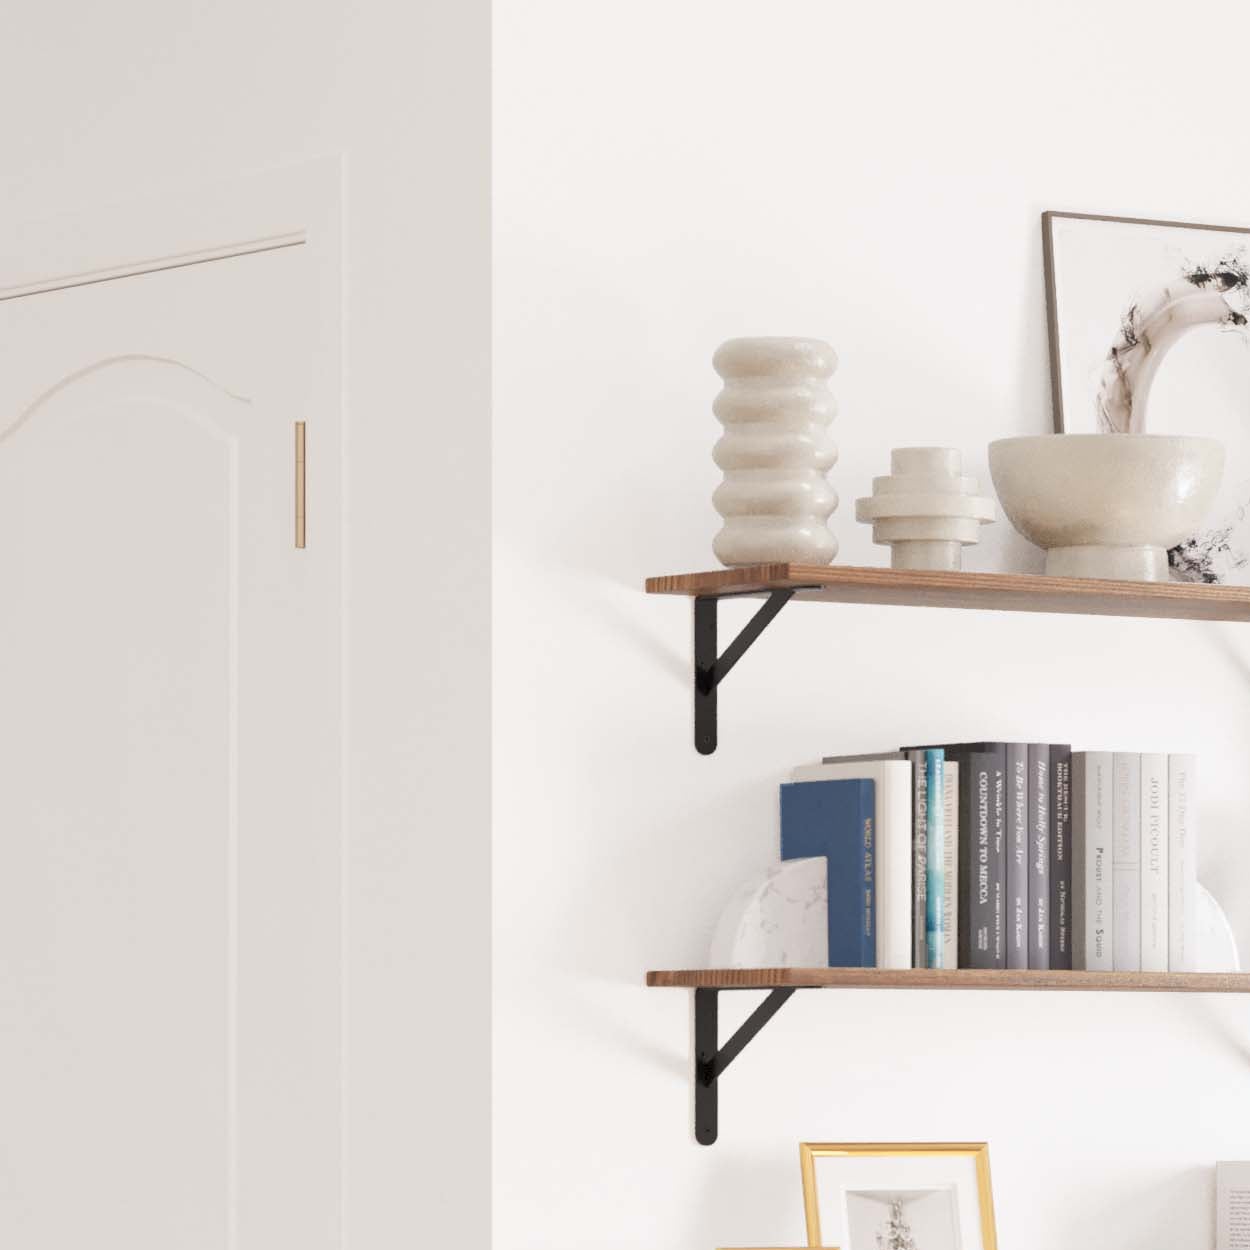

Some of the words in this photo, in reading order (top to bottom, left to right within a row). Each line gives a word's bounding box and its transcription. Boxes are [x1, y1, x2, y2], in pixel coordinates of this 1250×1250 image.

[917, 762, 928, 787] THE
[1015, 761, 1024, 774] To
[1037, 761, 1046, 790] Home
[1015, 775, 1024, 788] Be
[1150, 777, 1160, 809] JODI
[978, 771, 988, 844] COUNTDOWN
[1015, 790, 1024, 823] Where
[1037, 793, 1046, 803] to
[917, 791, 928, 834] LIGHT
[1036, 804, 1046, 832] Holly
[917, 837, 928, 853] OF
[1015, 825, 1024, 845] You
[1150, 815, 1160, 875] PICOULT
[978, 847, 988, 863] TO
[1015, 846, 1024, 865] Are
[1036, 834, 1046, 875] Springs
[978, 865, 988, 905] MECCA
[1096, 887, 1104, 905] AND
[1096, 910, 1104, 924] THE
[1096, 929, 1104, 958] SQUID
